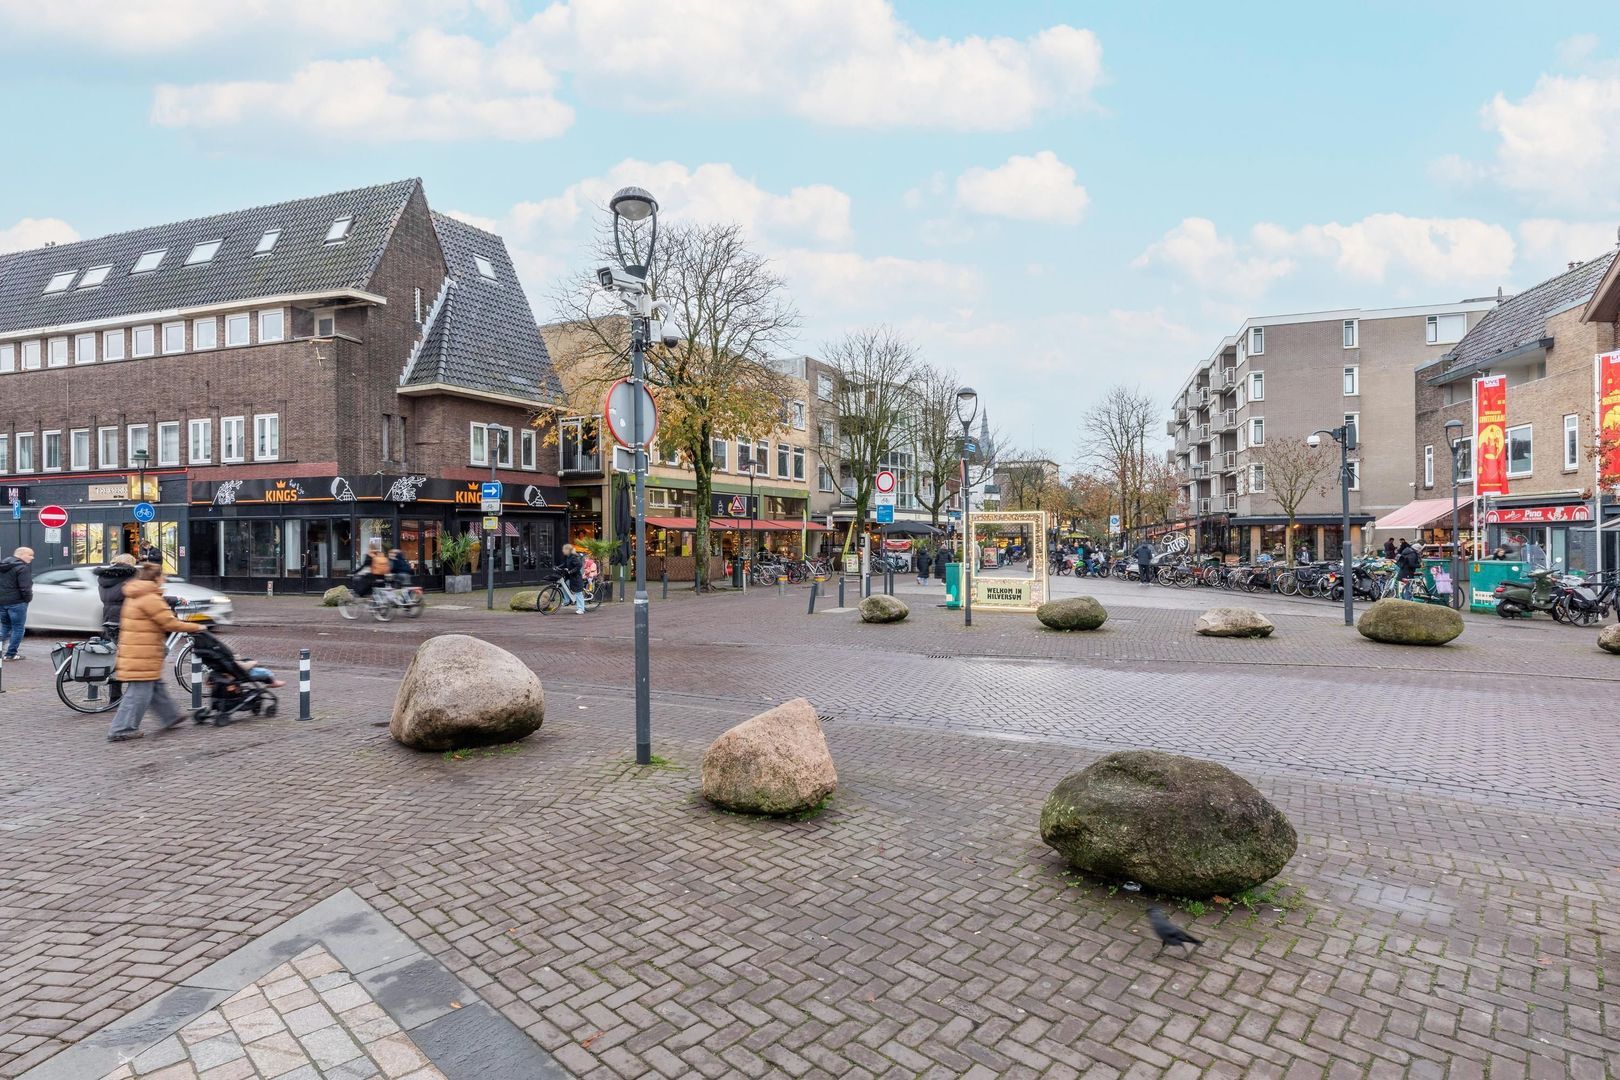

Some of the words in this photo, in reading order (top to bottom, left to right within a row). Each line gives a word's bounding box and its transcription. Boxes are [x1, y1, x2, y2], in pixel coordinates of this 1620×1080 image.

[265, 489, 298, 502] KINGS
[455, 491, 482, 504] KING
[1524, 509, 1542, 518] Pino
